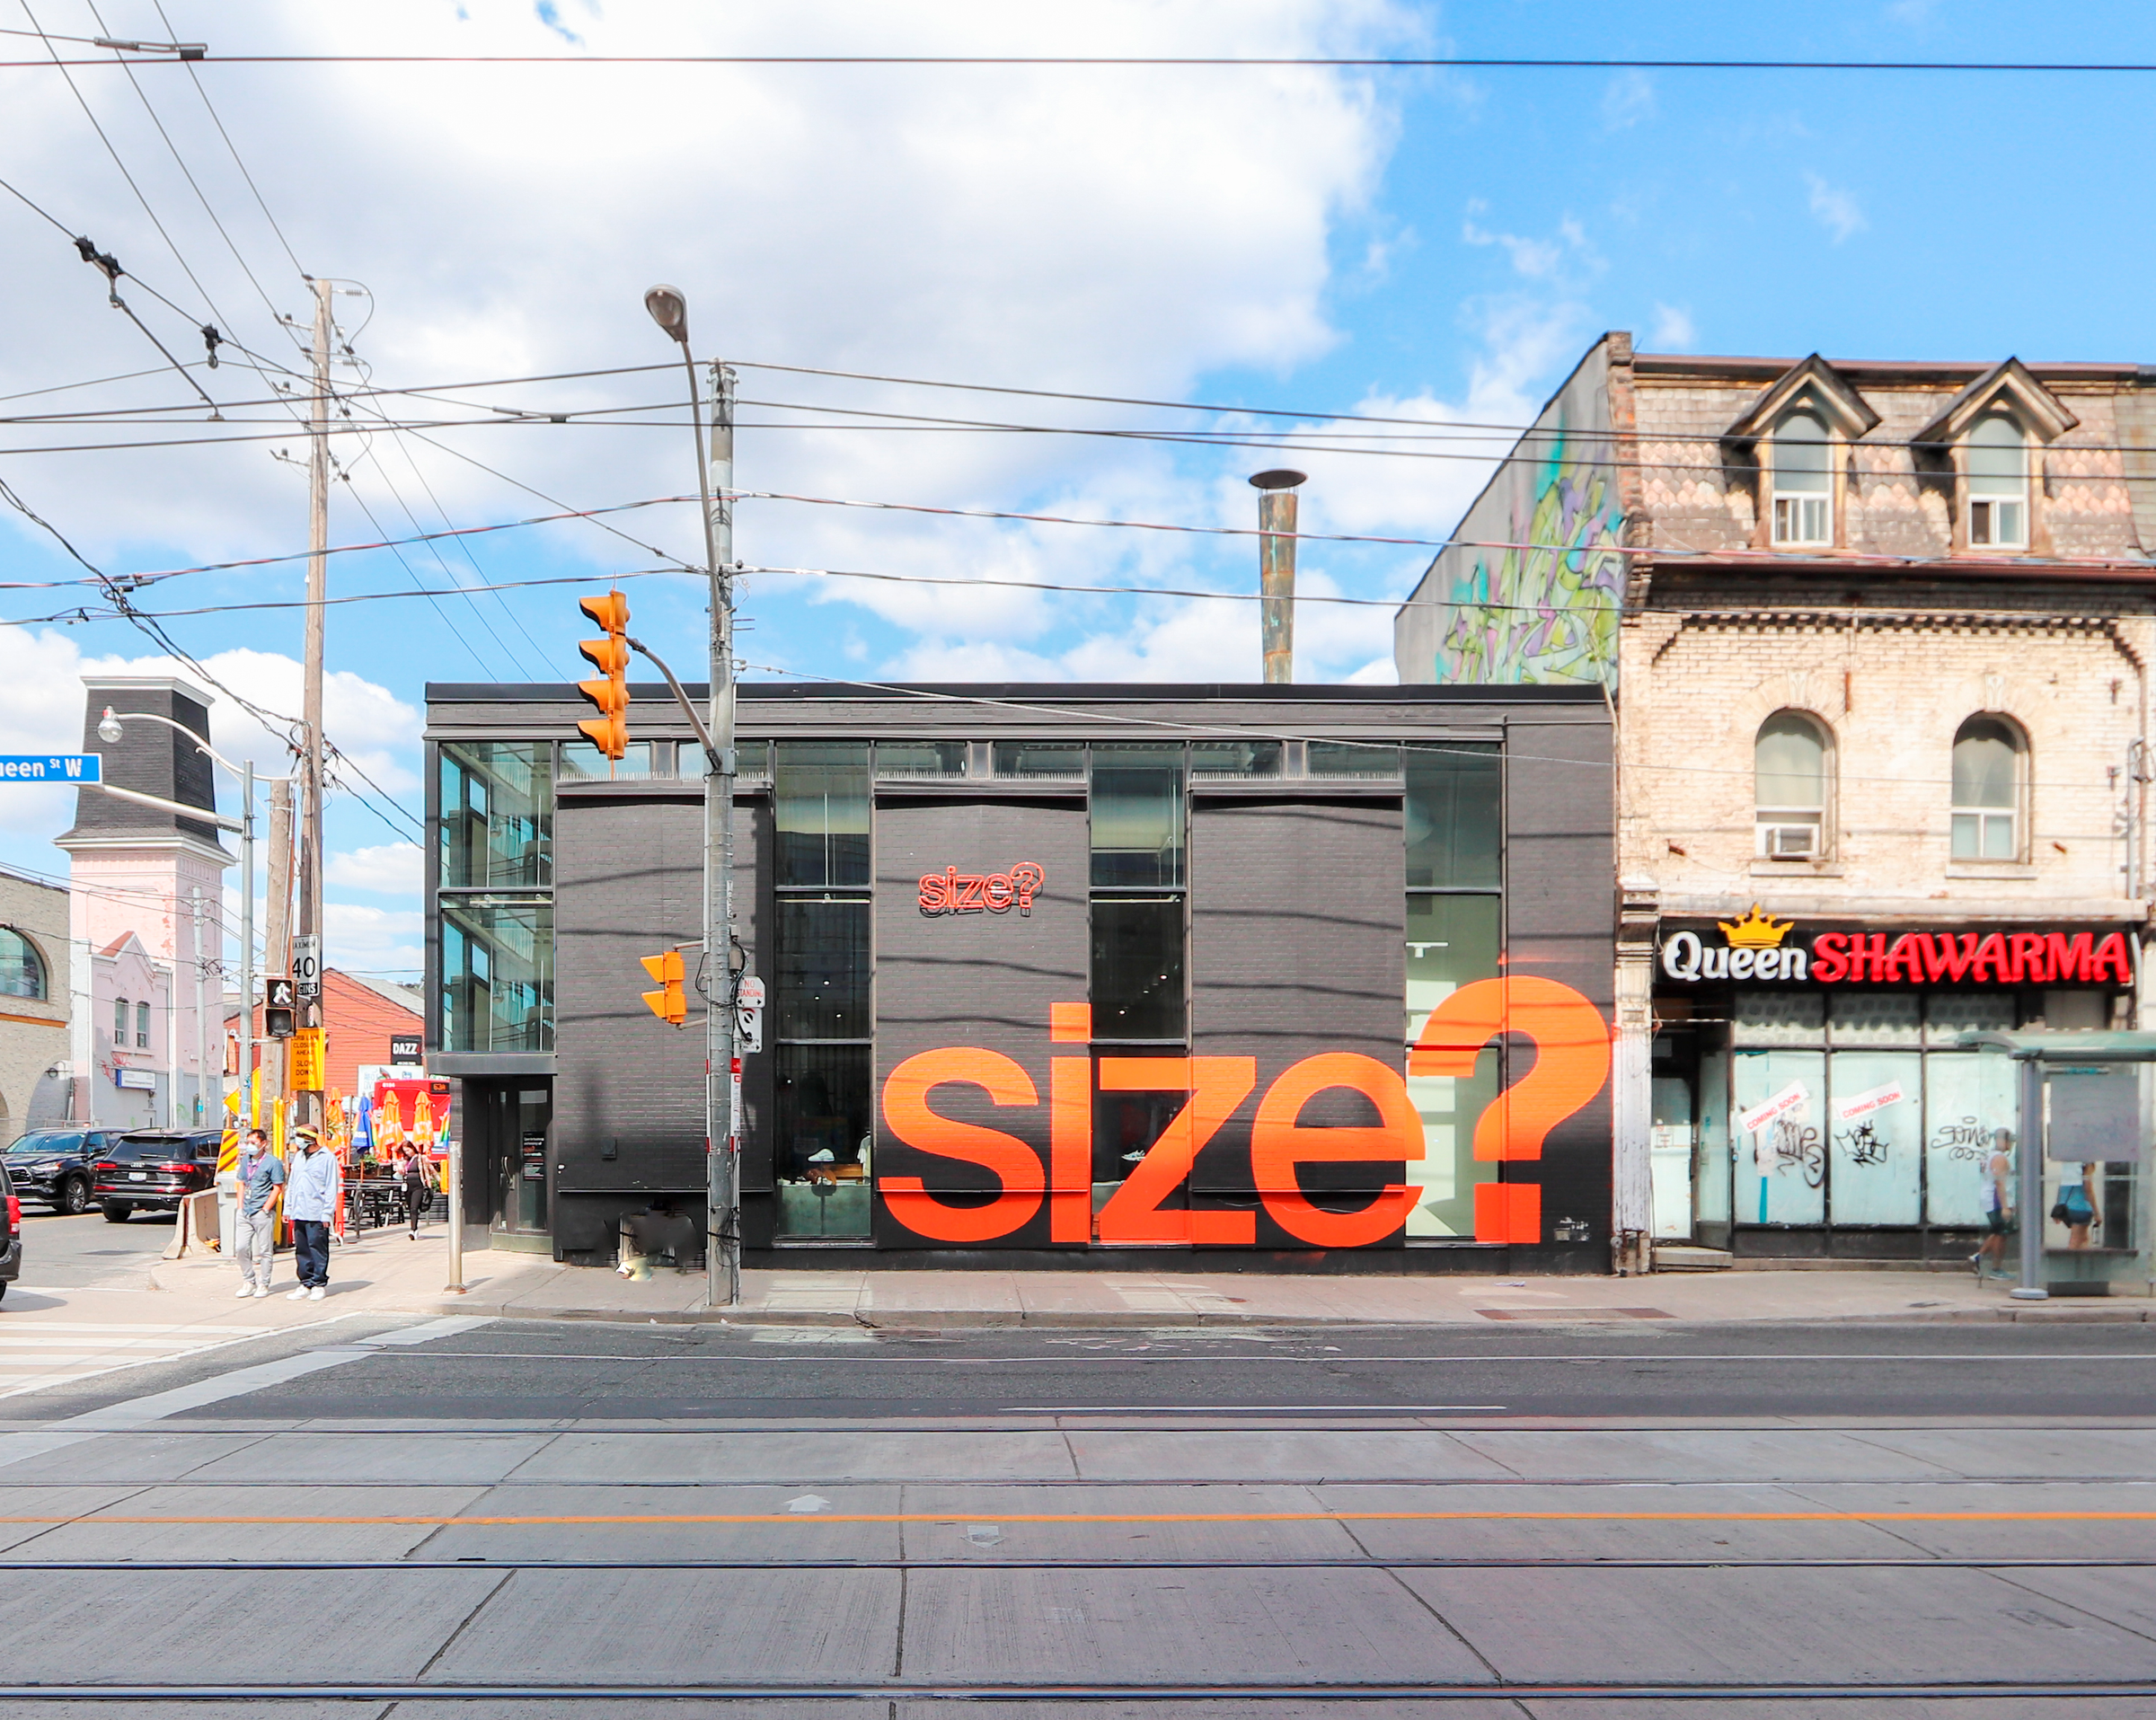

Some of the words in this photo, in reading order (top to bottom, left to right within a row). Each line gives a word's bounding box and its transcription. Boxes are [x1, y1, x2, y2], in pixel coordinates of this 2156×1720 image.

[49, 758, 61, 769] St
[65, 758, 82, 777] W
[918, 861, 1046, 909] size?
[293, 940, 315, 949] AXIMUM
[293, 957, 315, 978] 40
[1662, 931, 1808, 983] Queen
[1810, 931, 2132, 983] SHAWARMA
[297, 984, 316, 994] GINS
[737, 989, 764, 997] STANDING
[744, 980, 755, 988] NO
[879, 975, 1611, 1248] size?
[1746, 1108, 1779, 1130] COMING
[1778, 1092, 1801, 1111] SOON
[1842, 1100, 1876, 1119] COMING
[1878, 1090, 1901, 1107] SOON
